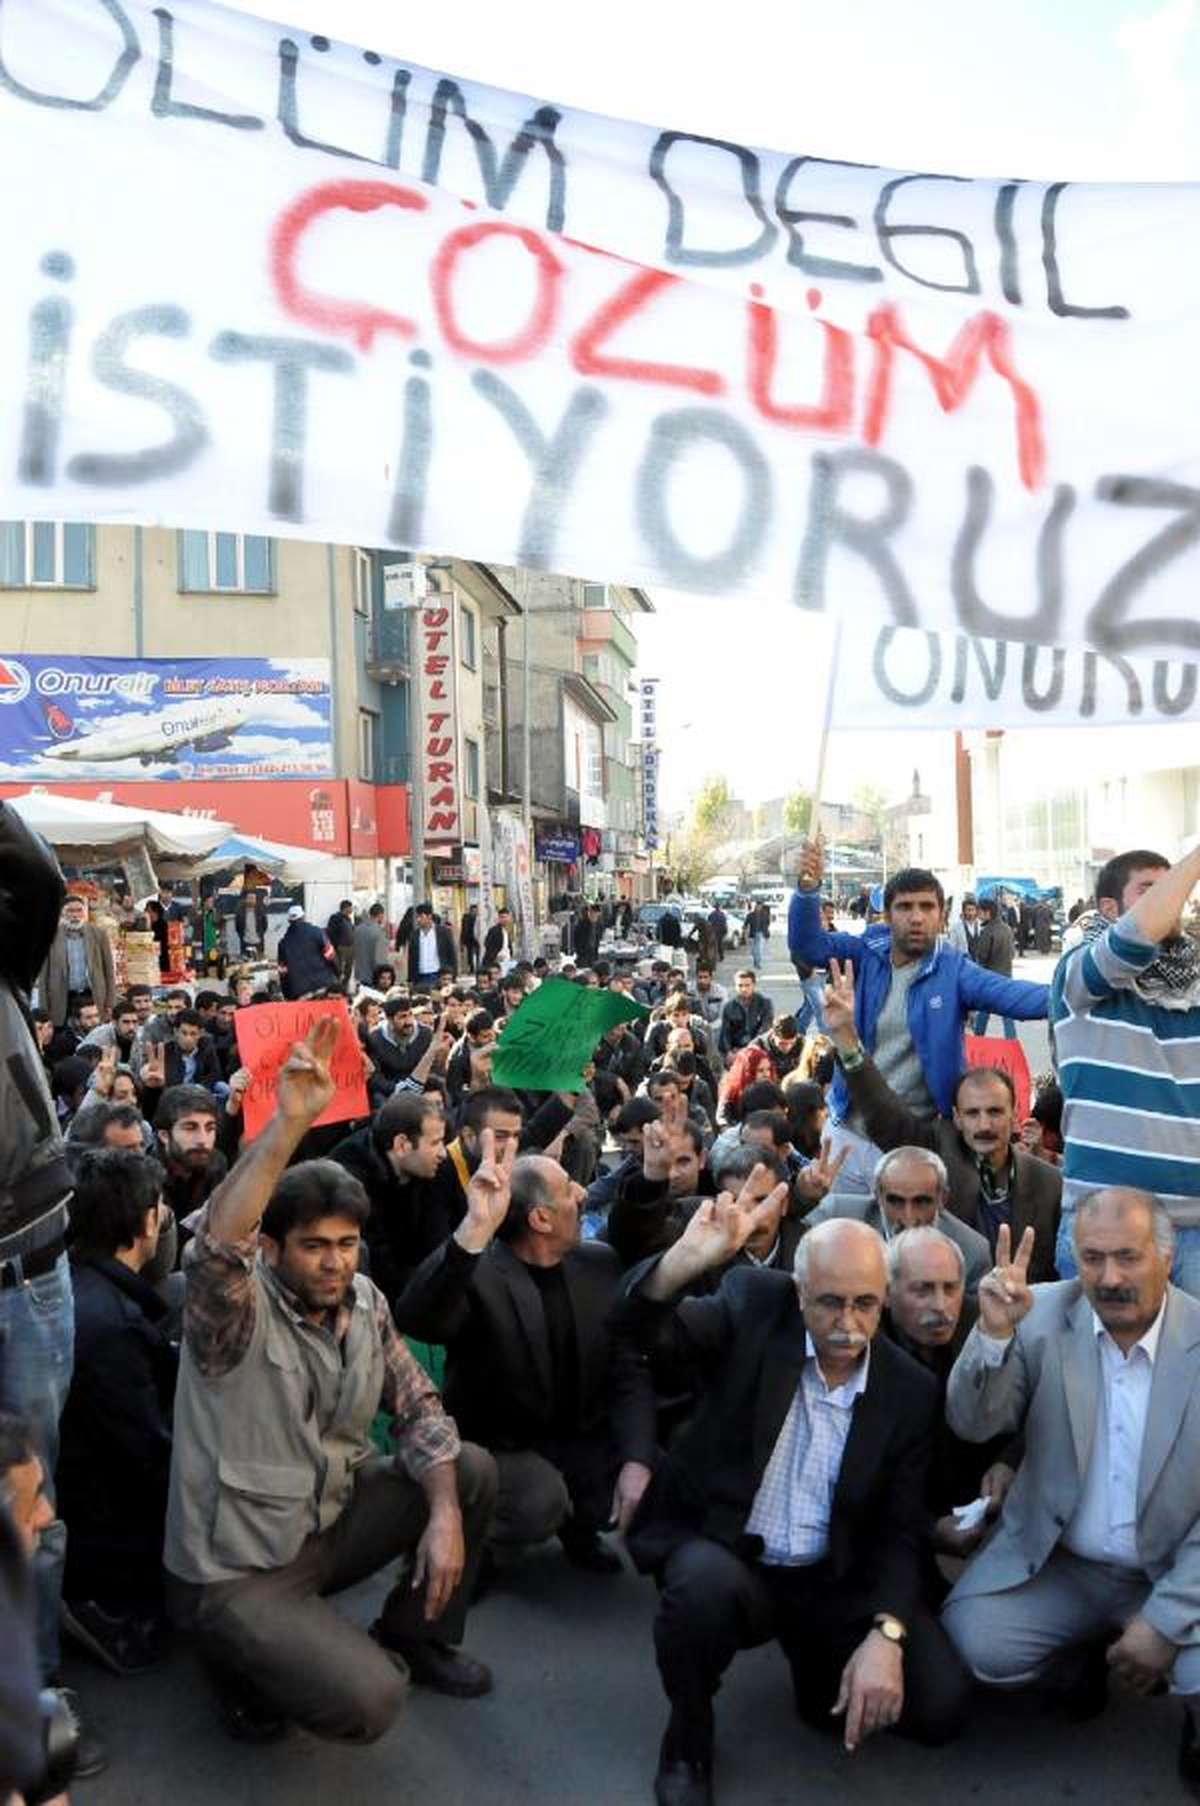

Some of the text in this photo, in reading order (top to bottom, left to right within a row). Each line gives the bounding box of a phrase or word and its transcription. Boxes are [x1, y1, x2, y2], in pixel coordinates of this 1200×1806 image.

[36, 668, 159, 695] Onurair
[423, 607, 457, 831] OTEL TURAN
